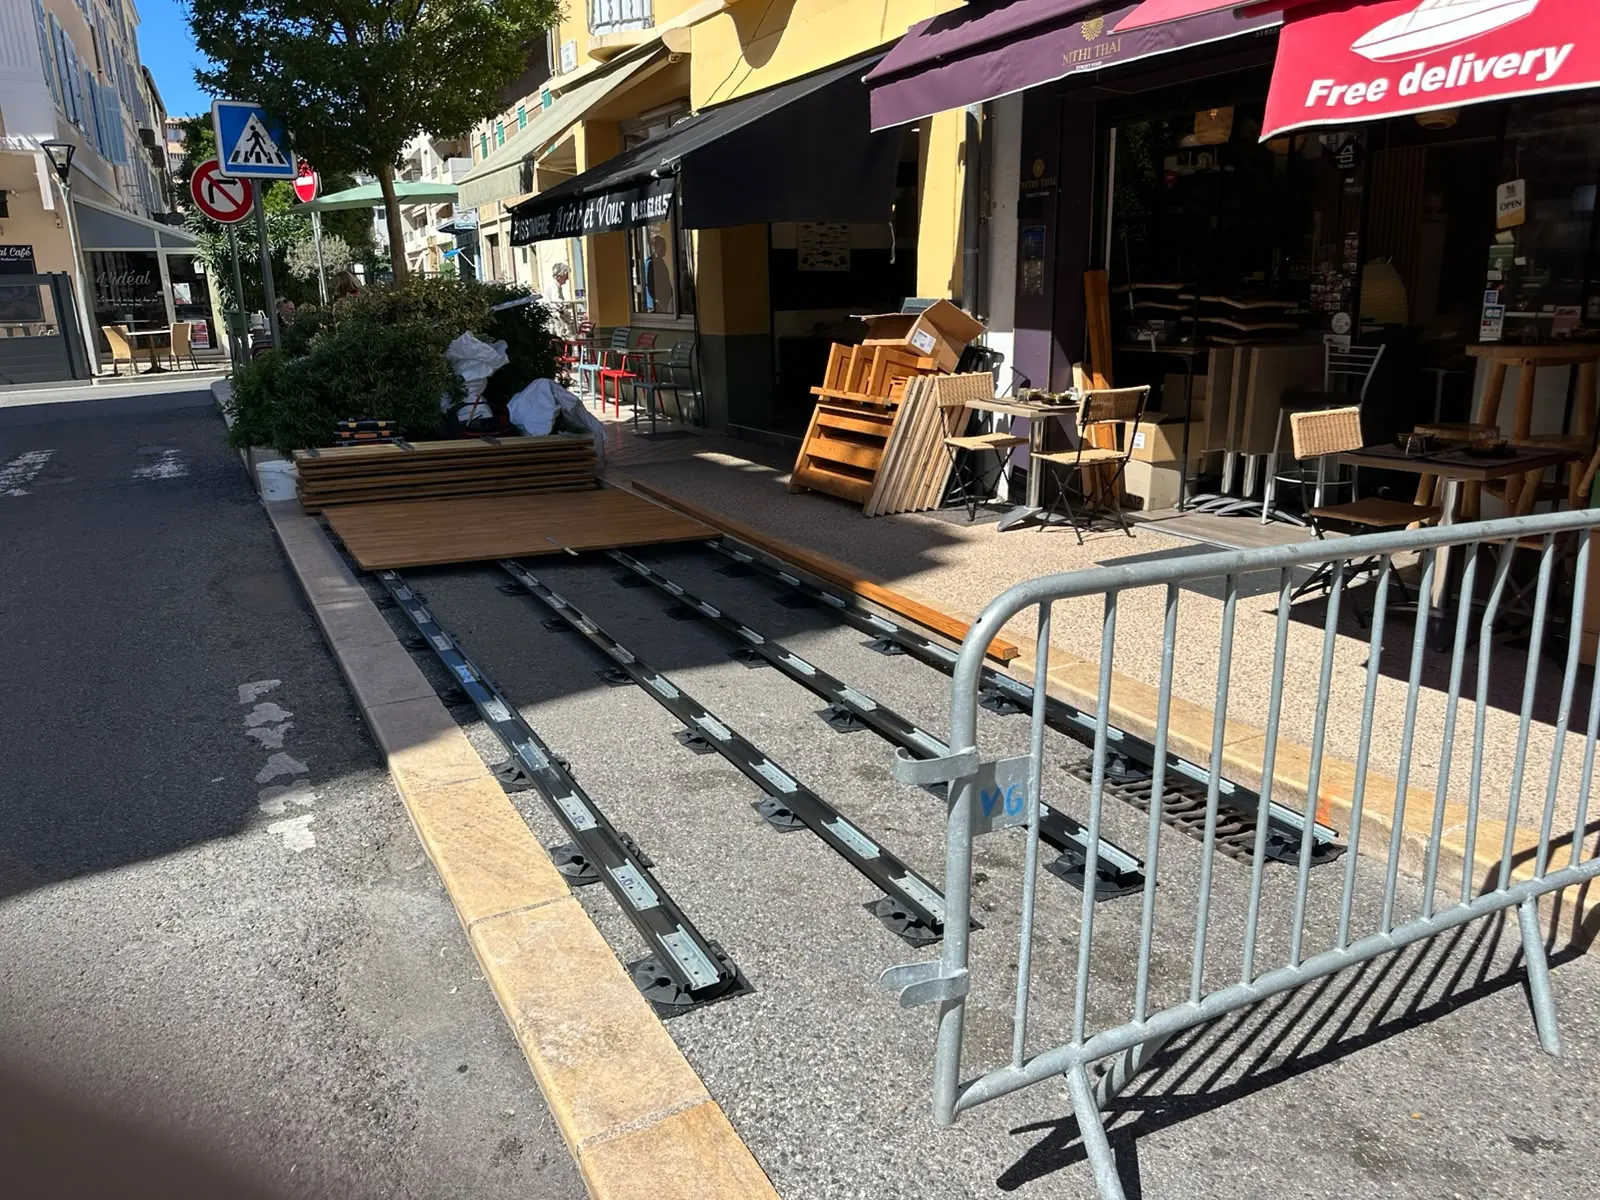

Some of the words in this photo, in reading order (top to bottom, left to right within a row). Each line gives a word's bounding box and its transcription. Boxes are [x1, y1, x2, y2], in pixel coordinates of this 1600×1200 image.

[1062, 47, 1091, 66] NITHI
[1094, 39, 1121, 58] THAI
[1304, 79, 1389, 108] Free
[1398, 43, 1575, 96] delivery
[584, 202, 595, 229] et
[596, 194, 625, 227] Vous
[1499, 199, 1522, 212] OPEN
[10, 246, 31, 259] Café
[96, 269, 151, 288] L'idéal
[979, 783, 1025, 817] VG
